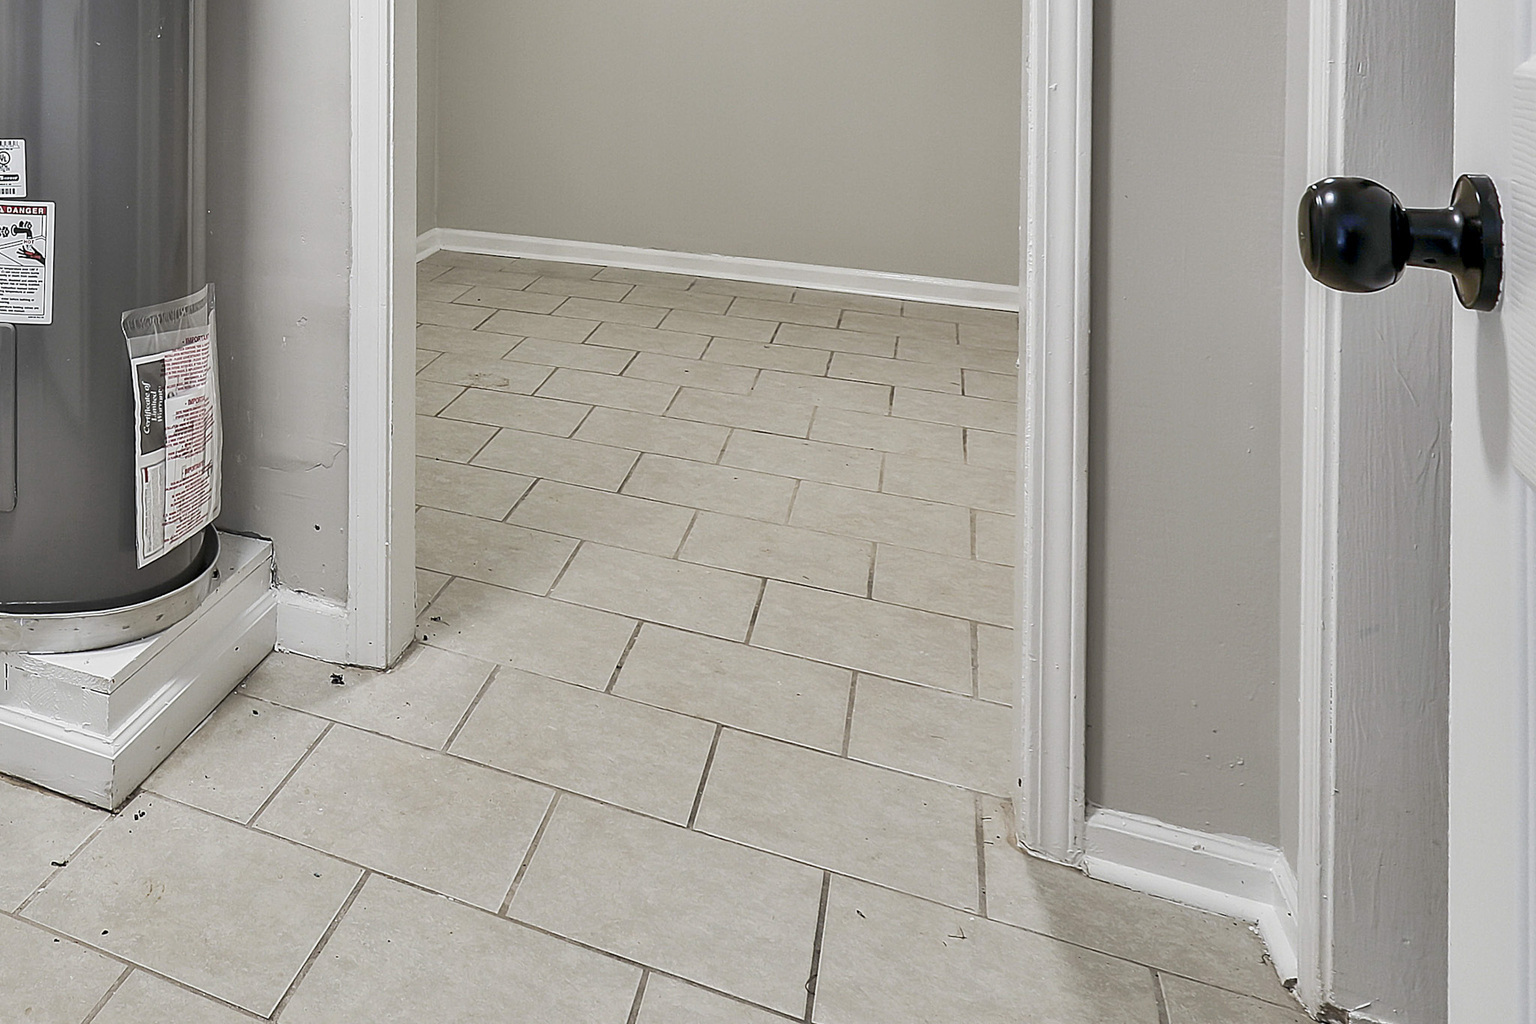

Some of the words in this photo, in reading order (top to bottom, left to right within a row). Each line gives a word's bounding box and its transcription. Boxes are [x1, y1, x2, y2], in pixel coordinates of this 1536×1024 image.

[6, 206, 45, 215] DANGER
[141, 380, 151, 392] of
[143, 392, 151, 435] Certificate
